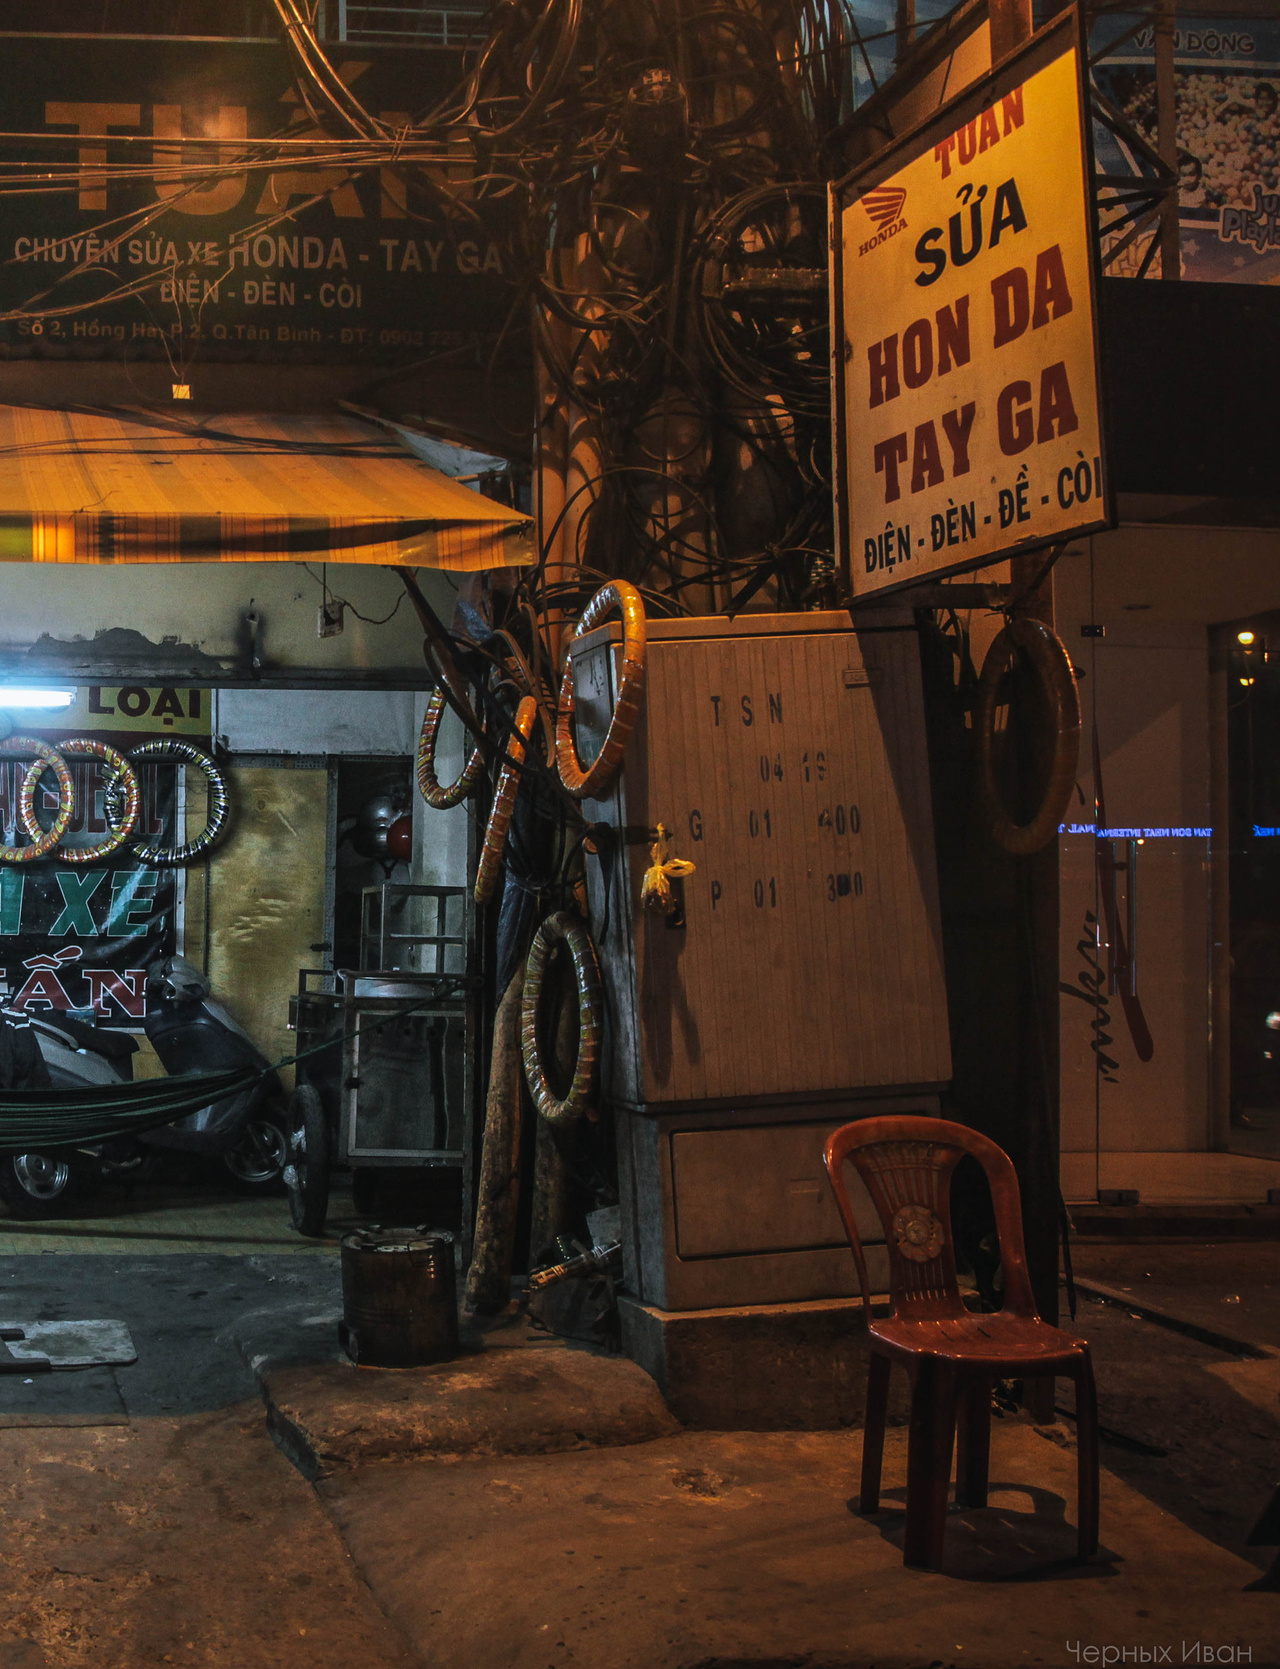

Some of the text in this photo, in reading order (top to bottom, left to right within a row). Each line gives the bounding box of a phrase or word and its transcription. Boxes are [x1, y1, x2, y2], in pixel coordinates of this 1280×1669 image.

[1186, 30, 1256, 56] ĐỘNG
[14, 233, 119, 264] CHUYÊN
[128, 231, 179, 265] SỬA
[187, 241, 219, 266] XE
[229, 234, 348, 271] HONDA
[379, 239, 444, 272] TAY
[456, 240, 504, 275] GA
[858, 216, 908, 257] HONDA
[914, 177, 1027, 287] SỬA
[160, 272, 220, 308] ĐIỆN
[243, 273, 295, 306] ĐÈN
[319, 276, 362, 308] CÒI
[867, 295, 970, 409] HON
[993, 243, 1073, 349] DA
[874, 360, 1079, 504] TAY GA
[864, 521, 912, 575] ĐIỆN
[931, 498, 977, 553] ĐÈN
[998, 463, 1030, 530] ĐỀ
[1057, 450, 1102, 511] CÒI
[88, 686, 201, 725] LOẠI
[48, 868, 160, 937] XE
